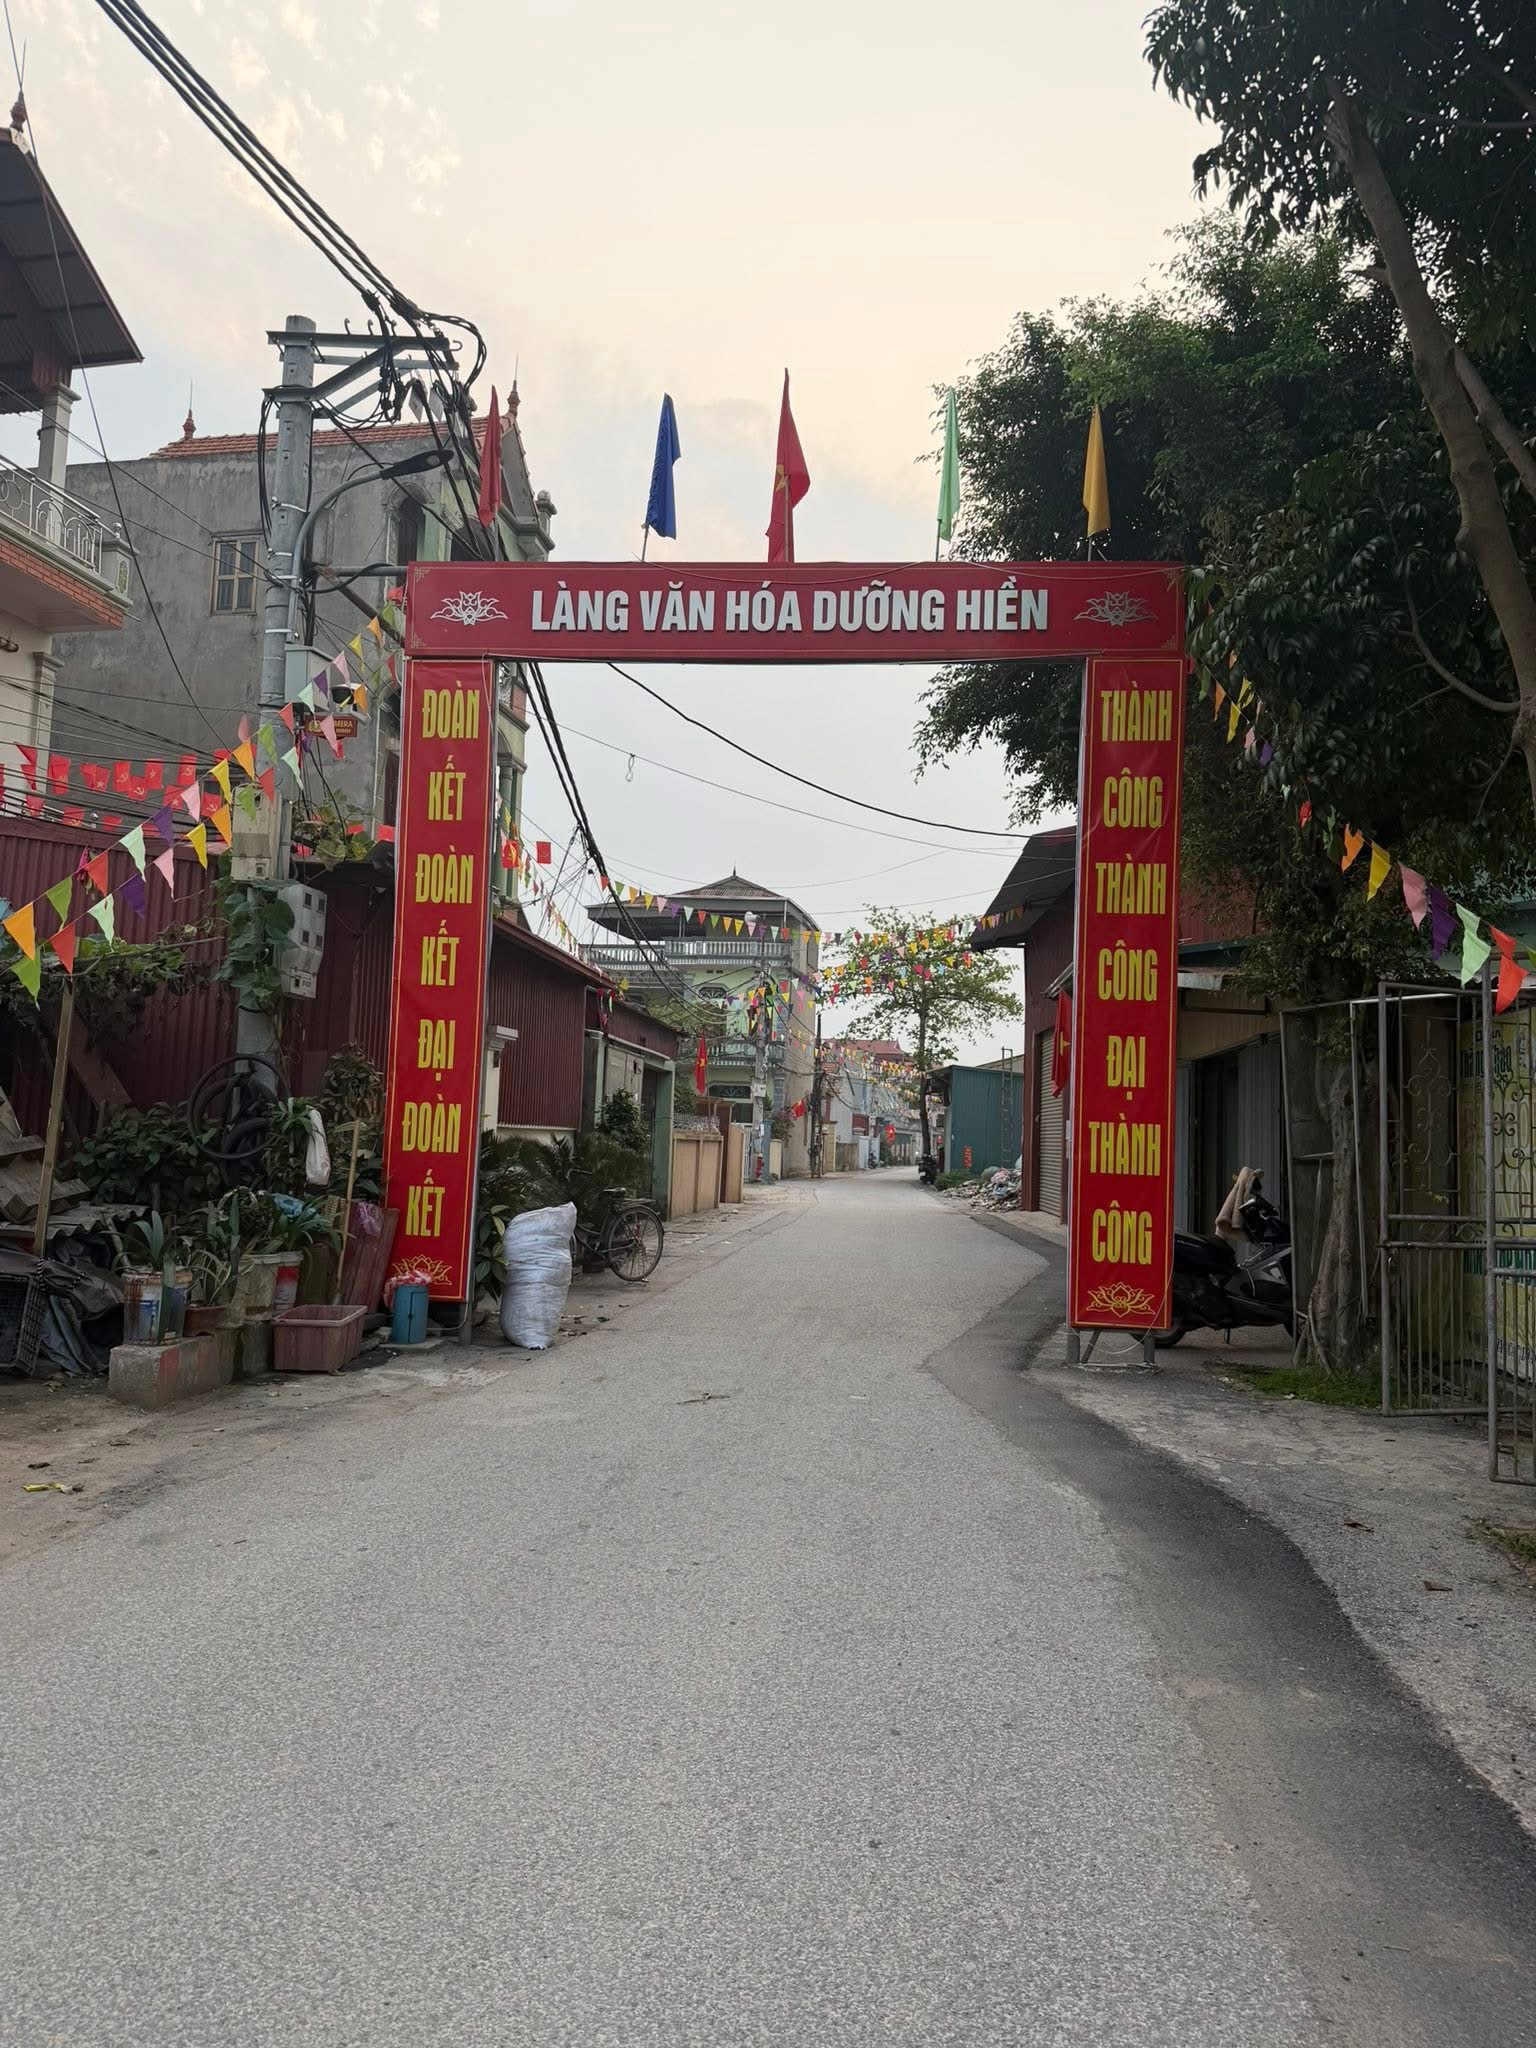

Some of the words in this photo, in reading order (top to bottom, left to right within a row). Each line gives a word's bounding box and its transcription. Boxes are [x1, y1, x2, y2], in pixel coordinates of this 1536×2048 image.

[532, 580, 628, 631] LÀNG
[640, 581, 714, 631] VĂN
[726, 581, 803, 631] HÓA
[813, 580, 944, 631] DƯỠNG
[957, 576, 1048, 631] HIỀN
[422, 681, 480, 738] ĐOÀN
[1101, 681, 1172, 742] THÀNH
[428, 756, 466, 821] KẾT
[1103, 768, 1162, 828] CÔNG
[415, 845, 474, 904] ĐOÀN
[1095, 854, 1166, 915] THÀNH
[420, 920, 460, 986] KẾT
[1098, 940, 1157, 1002] CÔNG
[417, 1019, 455, 1081] ĐẠI
[1106, 1036, 1146, 1100] ĐẠI
[401, 1094, 461, 1153] ĐOÀN
[1088, 1112, 1161, 1177] THÀNH
[405, 1169, 446, 1237] KẾT
[1092, 1200, 1153, 1265] CÔNG
